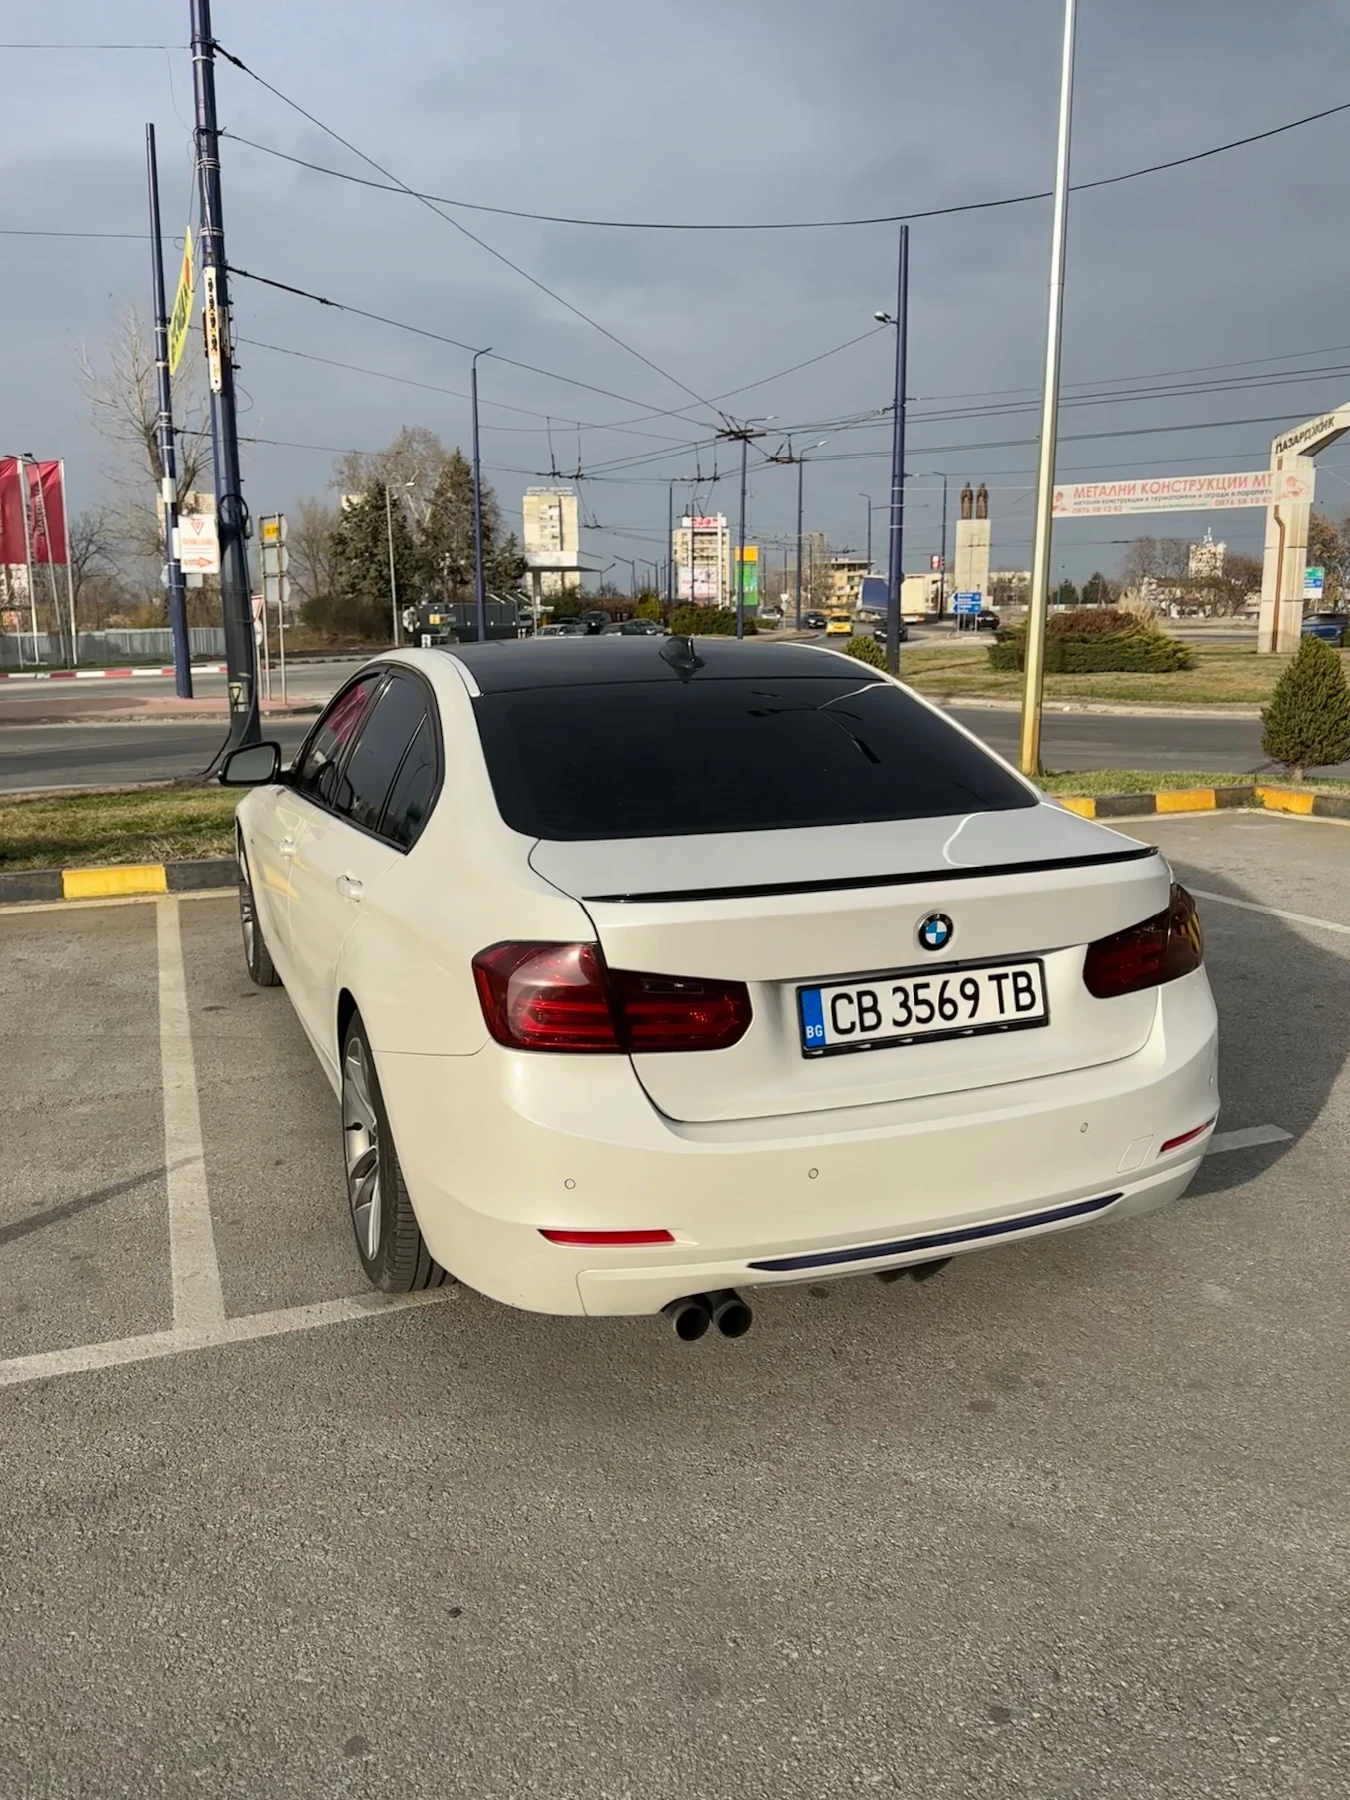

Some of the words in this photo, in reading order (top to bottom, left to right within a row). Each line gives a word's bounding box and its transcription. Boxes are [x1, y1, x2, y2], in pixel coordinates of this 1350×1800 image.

[1073, 484, 1136, 498] МЕТАЛНИ
[1141, 476, 1248, 494] КОНСТРУКЦИИ
[831, 990, 882, 1036] CB
[892, 977, 981, 1028] 3569
[988, 970, 1037, 1015] TB
[806, 1024, 823, 1039] BG
